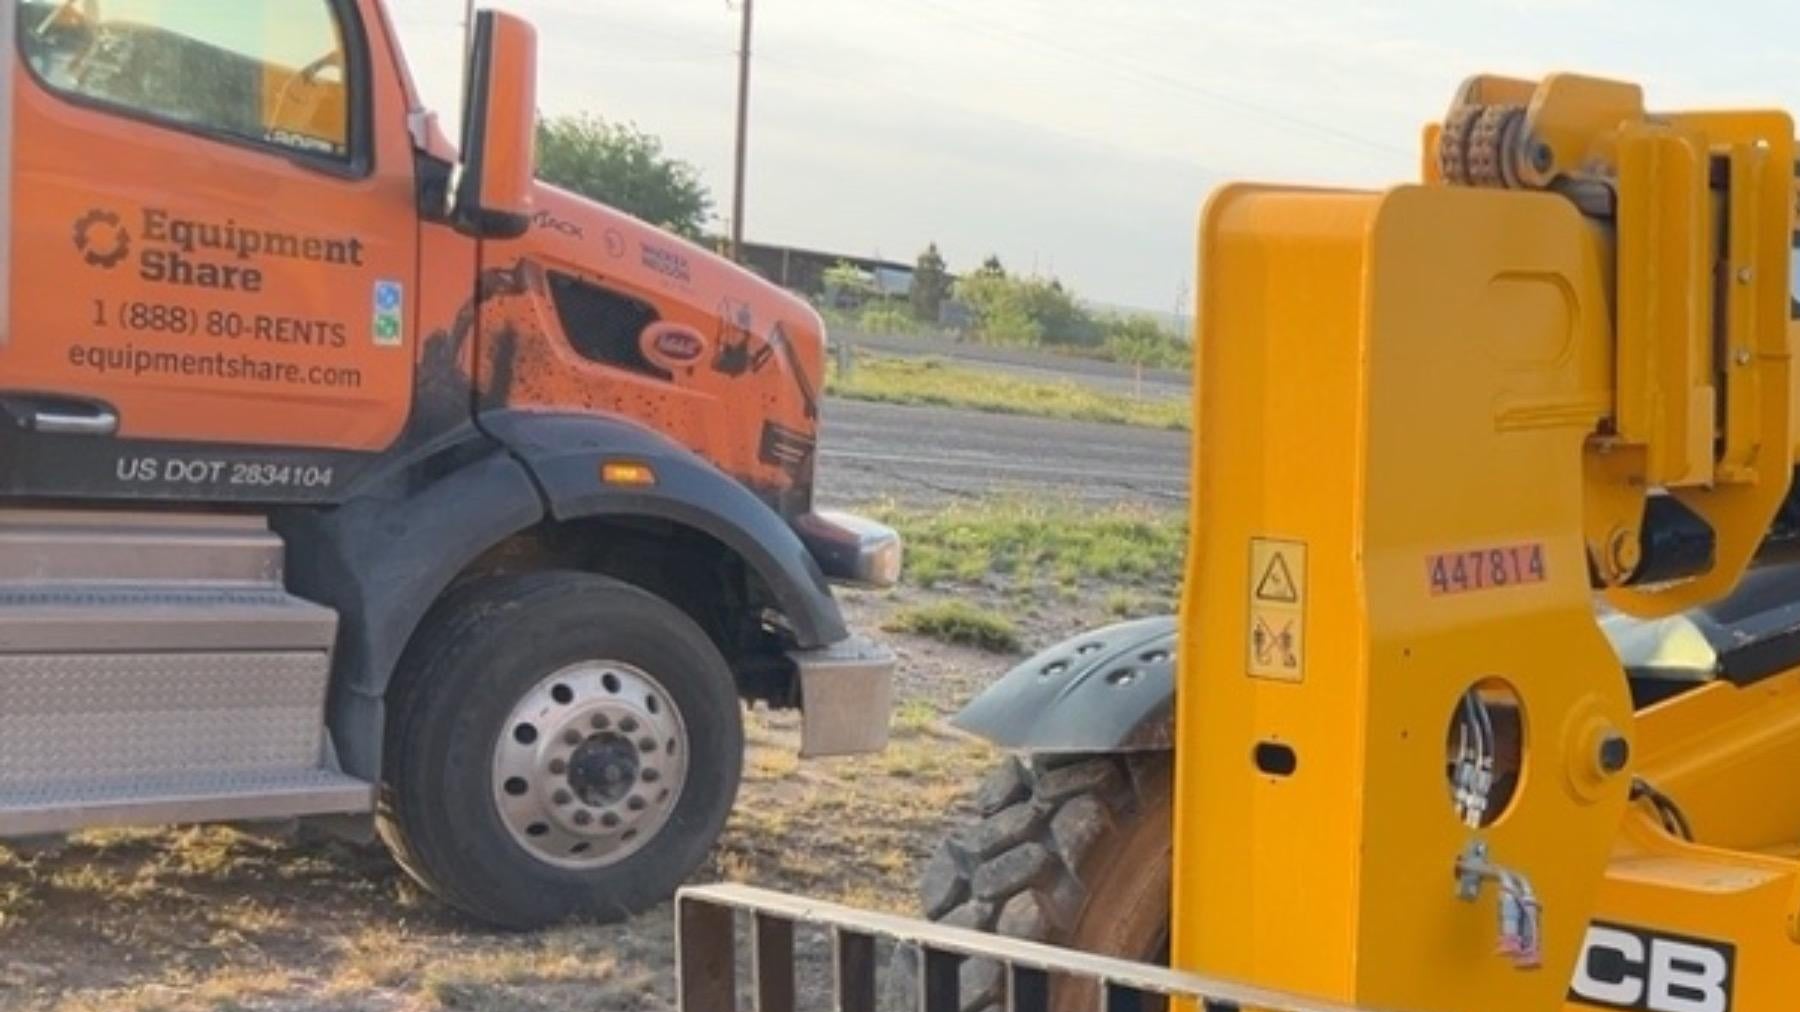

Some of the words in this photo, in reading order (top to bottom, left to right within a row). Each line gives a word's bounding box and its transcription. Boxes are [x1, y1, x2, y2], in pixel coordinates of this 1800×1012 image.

[140, 207, 364, 266] Equipment
[140, 249, 262, 292] Share
[93, 299, 107, 327] 1
[119, 302, 198, 335] (888)
[207, 311, 346, 347] 80-RENTS
[68, 342, 361, 388] equipmentshare.com
[116, 457, 158, 481] US
[164, 459, 226, 483] DOT
[230, 463, 334, 487] 2834104
[1431, 543, 1546, 592] 447814
